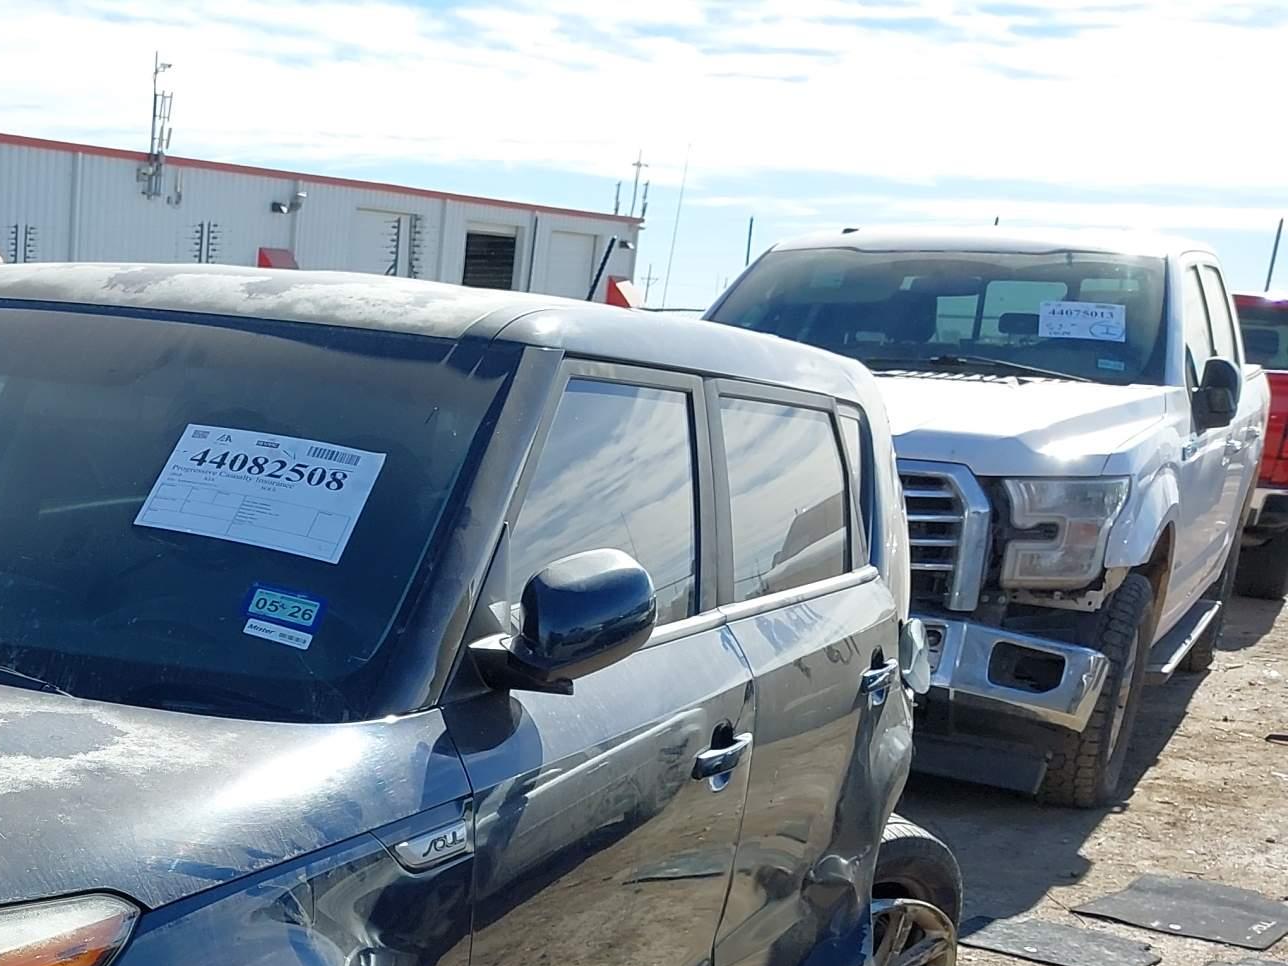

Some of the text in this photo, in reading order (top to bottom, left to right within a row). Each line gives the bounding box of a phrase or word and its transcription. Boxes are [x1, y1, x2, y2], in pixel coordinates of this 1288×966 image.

[172, 464, 218, 476] Progressive
[219, 471, 252, 481] Casualty
[255, 477, 295, 489] Insurance
[190, 448, 348, 491] 44082508
[255, 597, 314, 621] 05 26
[422, 831, 465, 857] SOUL
